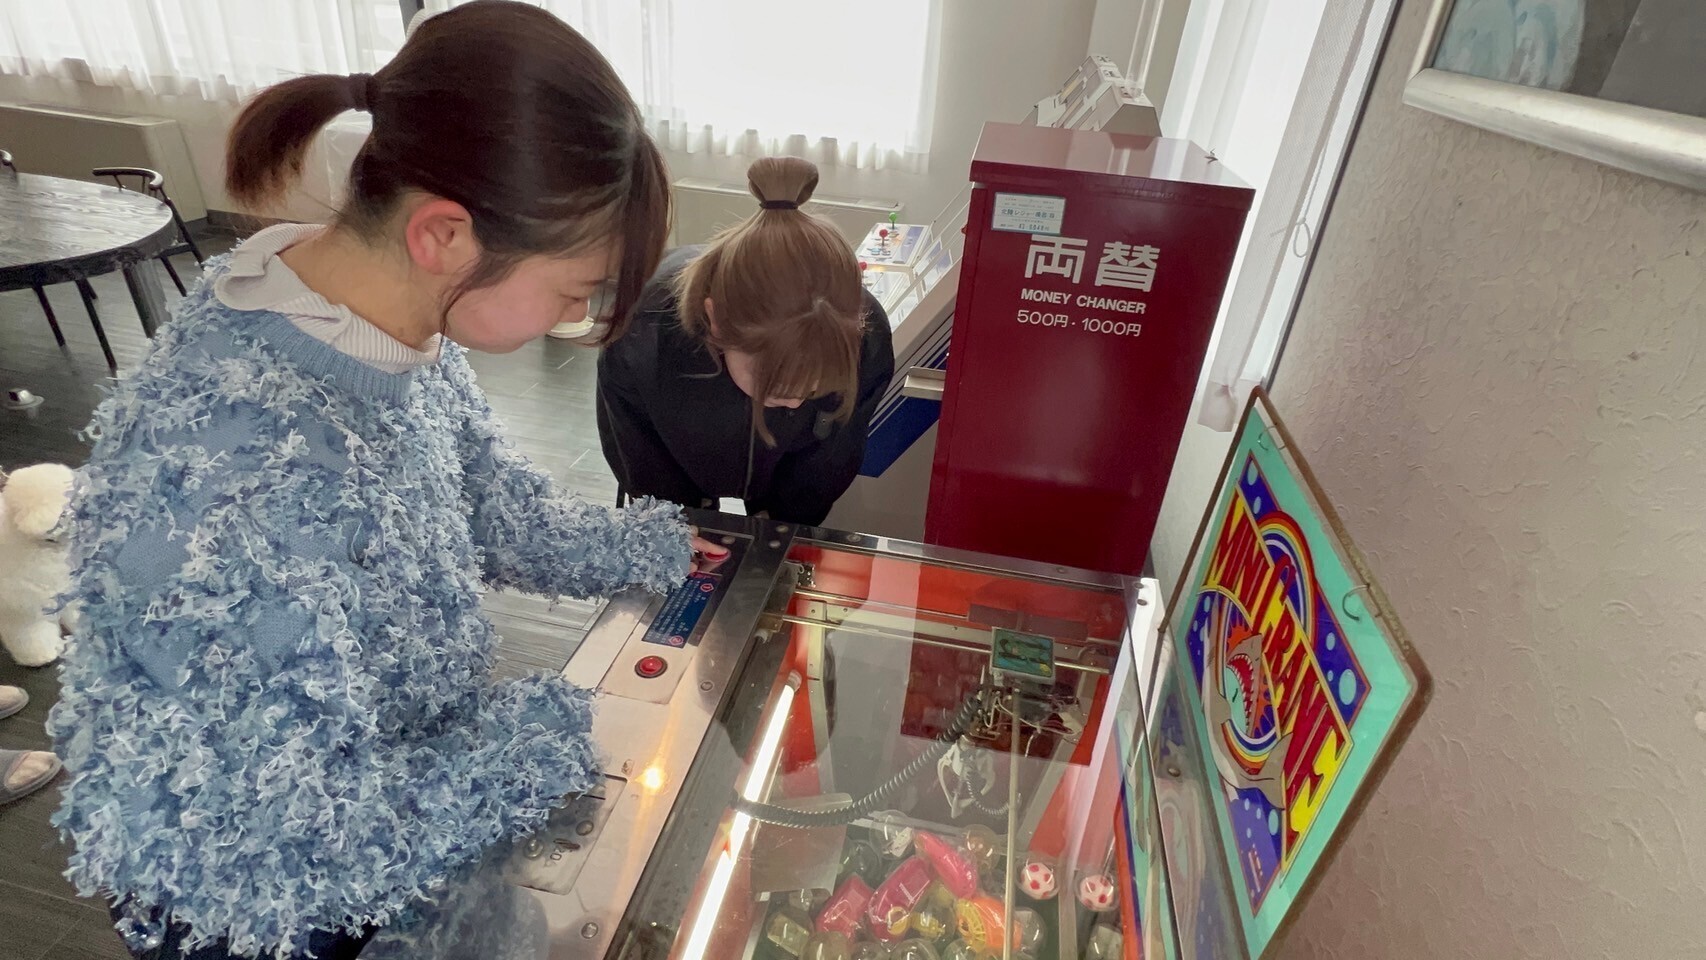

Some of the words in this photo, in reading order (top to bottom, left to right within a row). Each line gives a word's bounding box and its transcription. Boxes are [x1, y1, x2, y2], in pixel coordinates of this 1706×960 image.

[1024, 234, 1161, 292] 両替
[1020, 288, 1072, 305] MONEY
[1076, 295, 1147, 315] CHANGER
